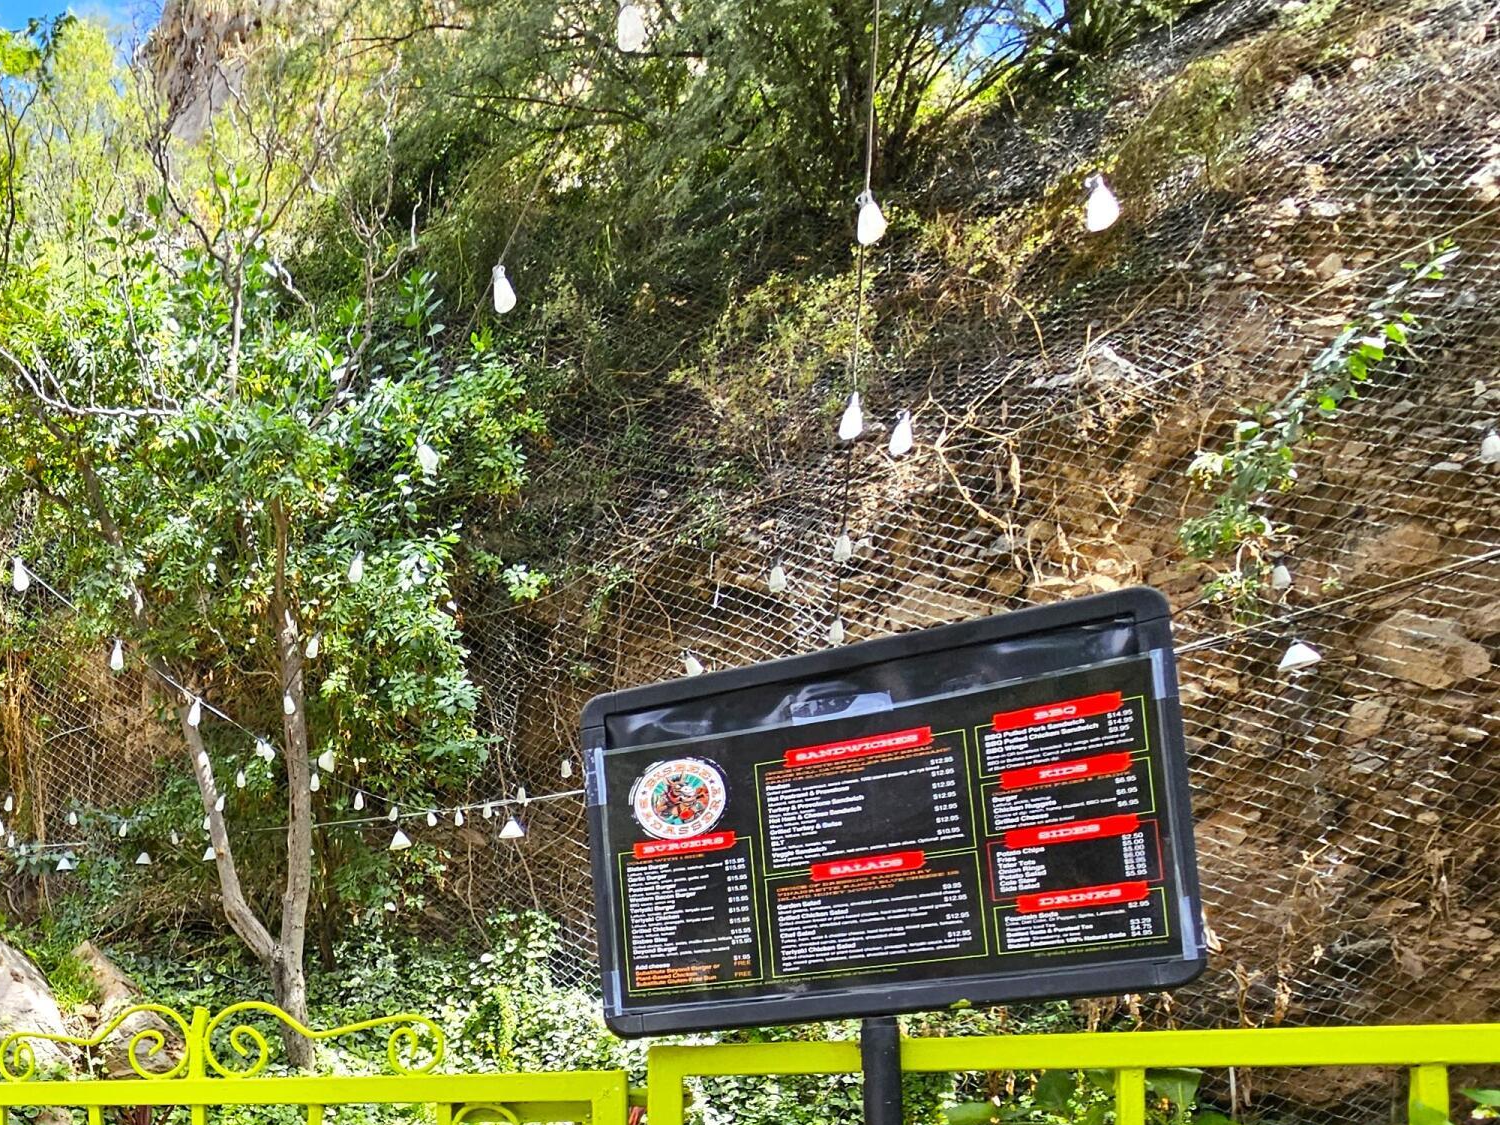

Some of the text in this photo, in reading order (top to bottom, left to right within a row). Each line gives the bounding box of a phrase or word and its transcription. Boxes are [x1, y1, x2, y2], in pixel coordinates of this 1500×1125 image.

[1034, 705, 1075, 719] BBQ
[1106, 709, 1132, 718] $14.95
[1107, 716, 1133, 726] $14.95
[984, 718, 1084, 741] BBQ Pulled Pork Sandwich
[984, 723, 1098, 747] BBQ Pulled Chicken Sandwich
[796, 734, 917, 760] SANDWICHES
[985, 743, 1028, 754] BBQ Wings
[930, 756, 953, 765] $12.95
[644, 763, 712, 789] BISBEE
[931, 767, 954, 776] $12.95
[1039, 764, 1087, 778] KIDS
[931, 779, 955, 788] $12.95
[831, 794, 864, 804] Sandwich
[932, 790, 956, 799] $12.95
[991, 794, 1017, 803] Burger
[829, 805, 861, 815] Sandwich
[934, 802, 957, 811] $12.95
[993, 805, 1023, 814] Chicken
[1024, 799, 1056, 809] Nuggets
[935, 814, 959, 823] $12.95
[994, 816, 1019, 825] Grilled
[1020, 813, 1049, 821] Cheese
[769, 827, 791, 835] Grilled
[791, 824, 814, 832] Turkey
[936, 826, 960, 835] $10.95
[1038, 824, 1099, 838] SIDES
[643, 837, 723, 853] BURGERS
[771, 846, 827, 858] Veggie Sandwich
[996, 846, 1044, 858] Potato Chips
[724, 863, 745, 871] $15.95
[830, 858, 902, 874] SALADS
[997, 864, 1045, 875] Onion Rings
[726, 873, 747, 881] $15.95
[1024, 869, 1046, 877] Salad
[655, 881, 676, 890] Burger
[727, 884, 747, 892] $15.95
[1018, 882, 1040, 890] Salad
[943, 893, 967, 902] $12.95
[1039, 889, 1120, 905] DRINKS
[728, 905, 748, 913] $15.95
[776, 899, 821, 910] Garden Salad
[630, 916, 654, 925] Teriyaki
[654, 912, 679, 921] Chicken
[945, 911, 969, 919] $12.95
[947, 929, 971, 937] $12.95
[780, 947, 807, 955] Teriyaki
